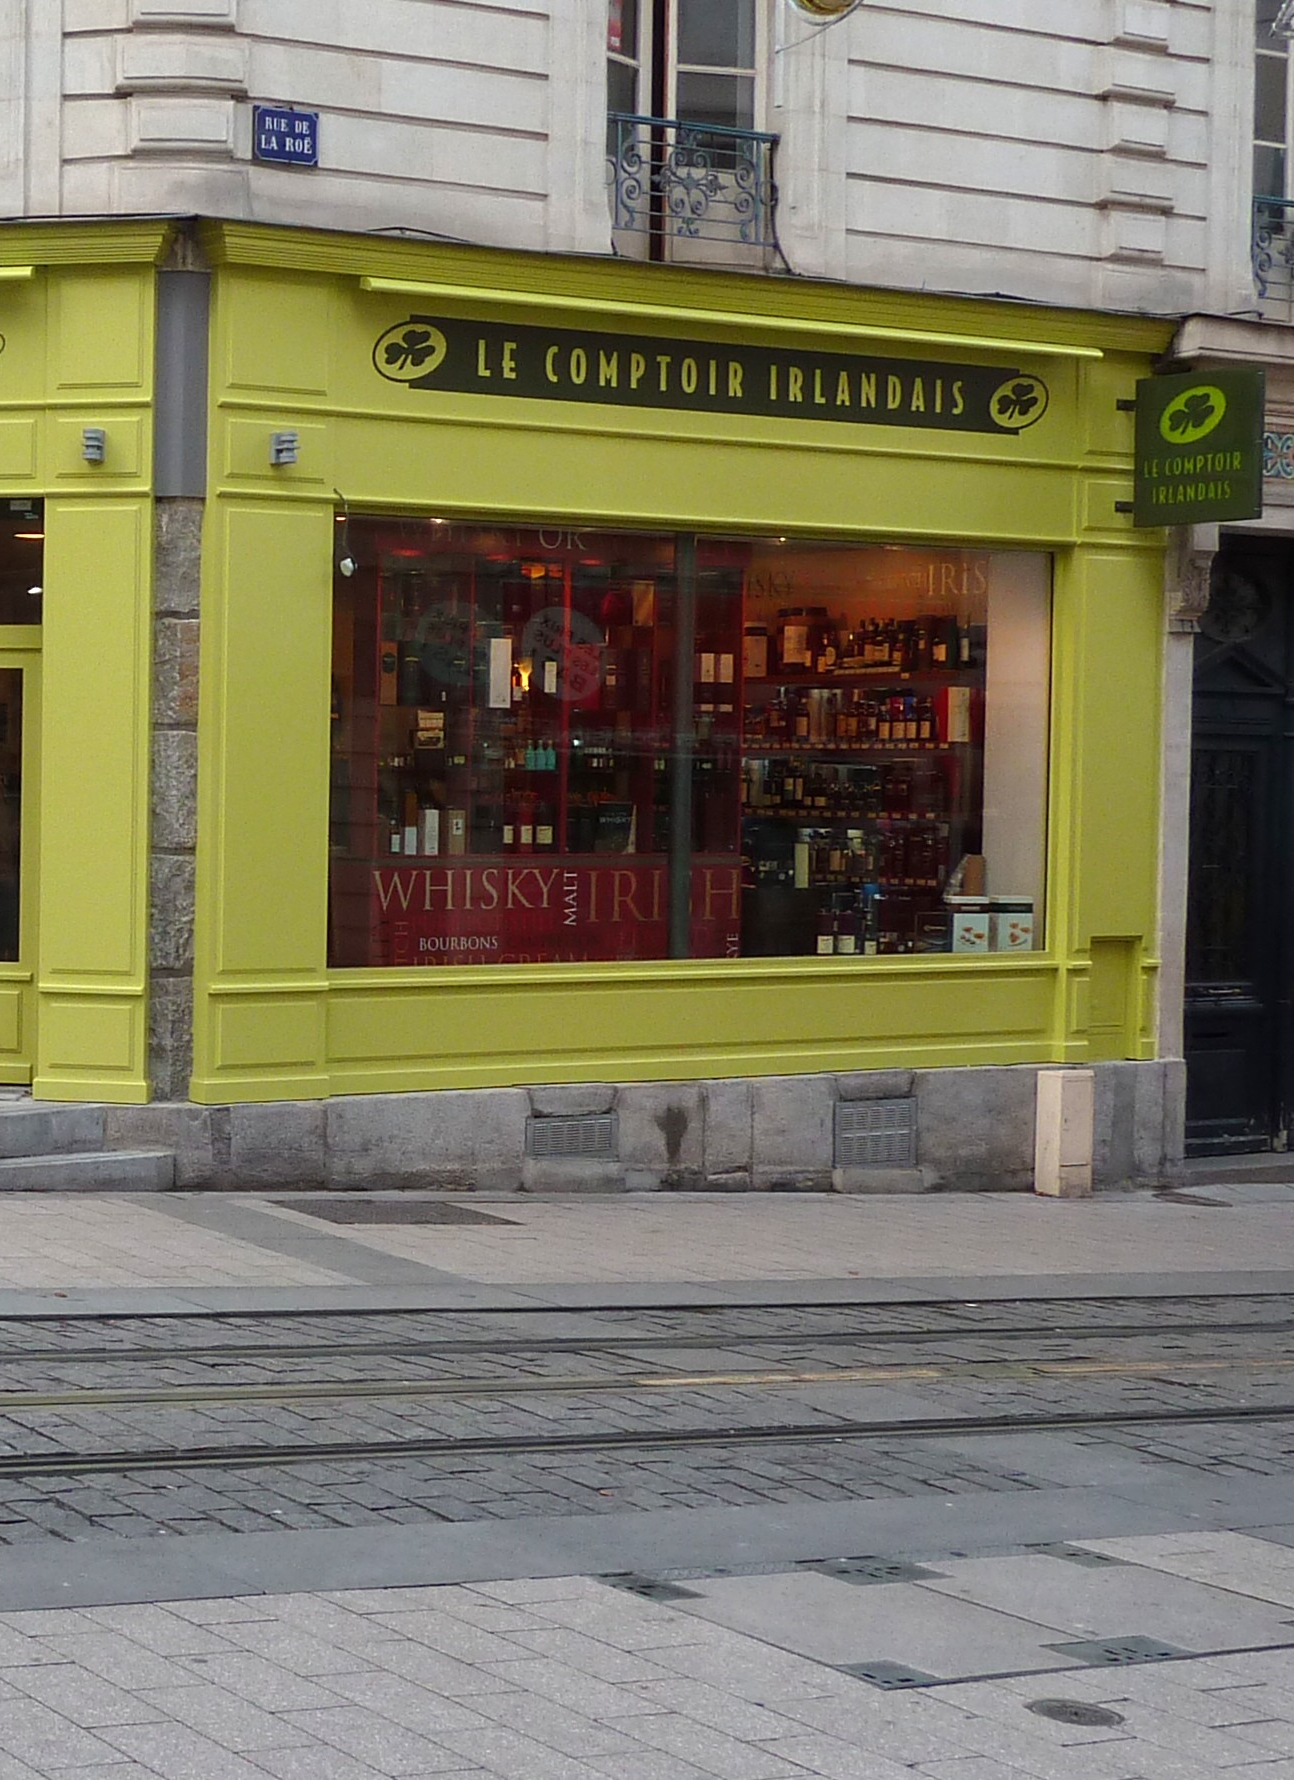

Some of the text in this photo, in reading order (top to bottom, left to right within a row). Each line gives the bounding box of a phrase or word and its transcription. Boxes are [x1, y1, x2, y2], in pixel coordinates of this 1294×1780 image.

[265, 116, 310, 134] RUE DE
[260, 134, 278, 150] LA
[477, 339, 964, 415] LE COMPTOIR IRLANDAIS
[1143, 451, 1242, 478] LE COMPTOIR
[1152, 481, 1232, 504] IRLANDAIS
[373, 868, 560, 913] WHISKY
[563, 870, 578, 926] MALT
[586, 869, 740, 922] IRIH
[419, 936, 498, 951] BOURBONS
